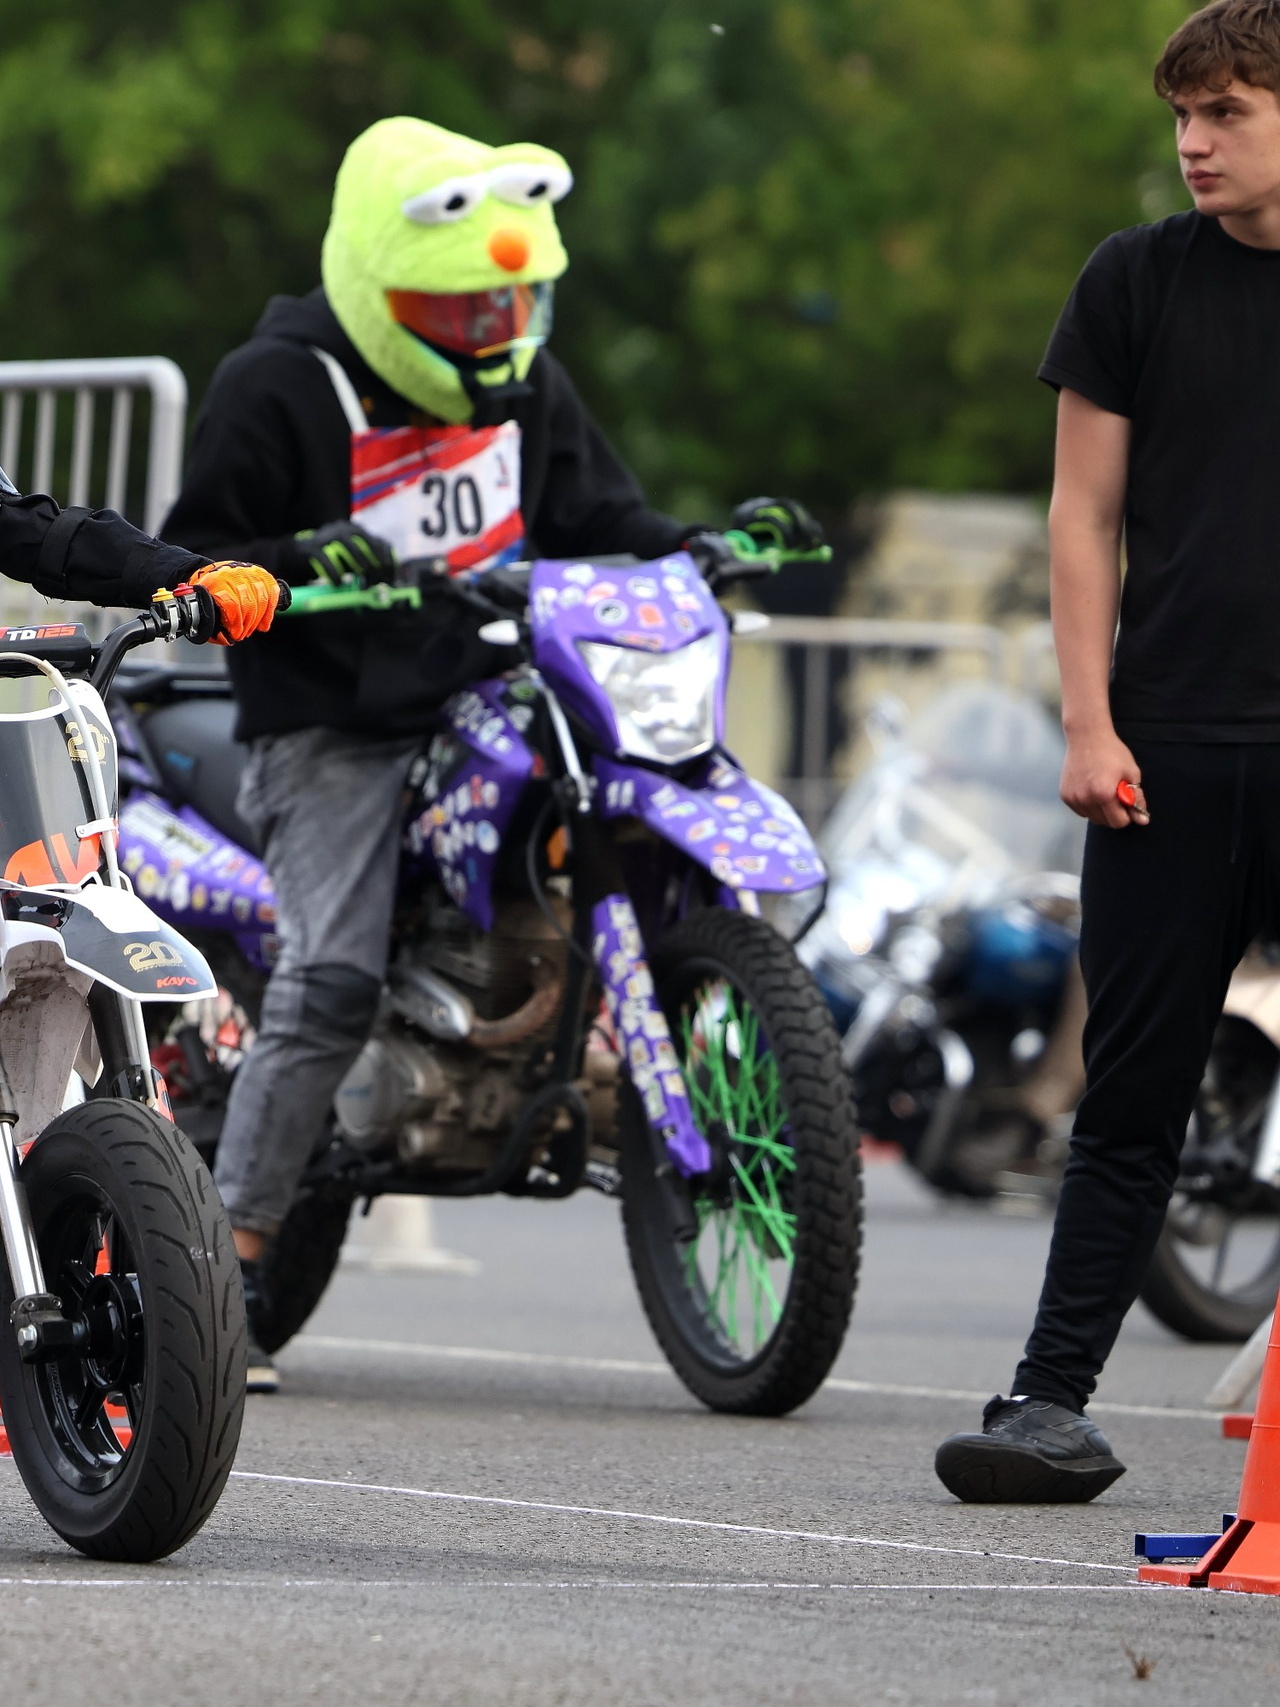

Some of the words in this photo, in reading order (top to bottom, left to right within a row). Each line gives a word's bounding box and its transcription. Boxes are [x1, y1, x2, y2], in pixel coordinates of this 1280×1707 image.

[420, 474, 483, 538] 30
[7, 625, 77, 642] TD125
[156, 976, 198, 989] KAYO
